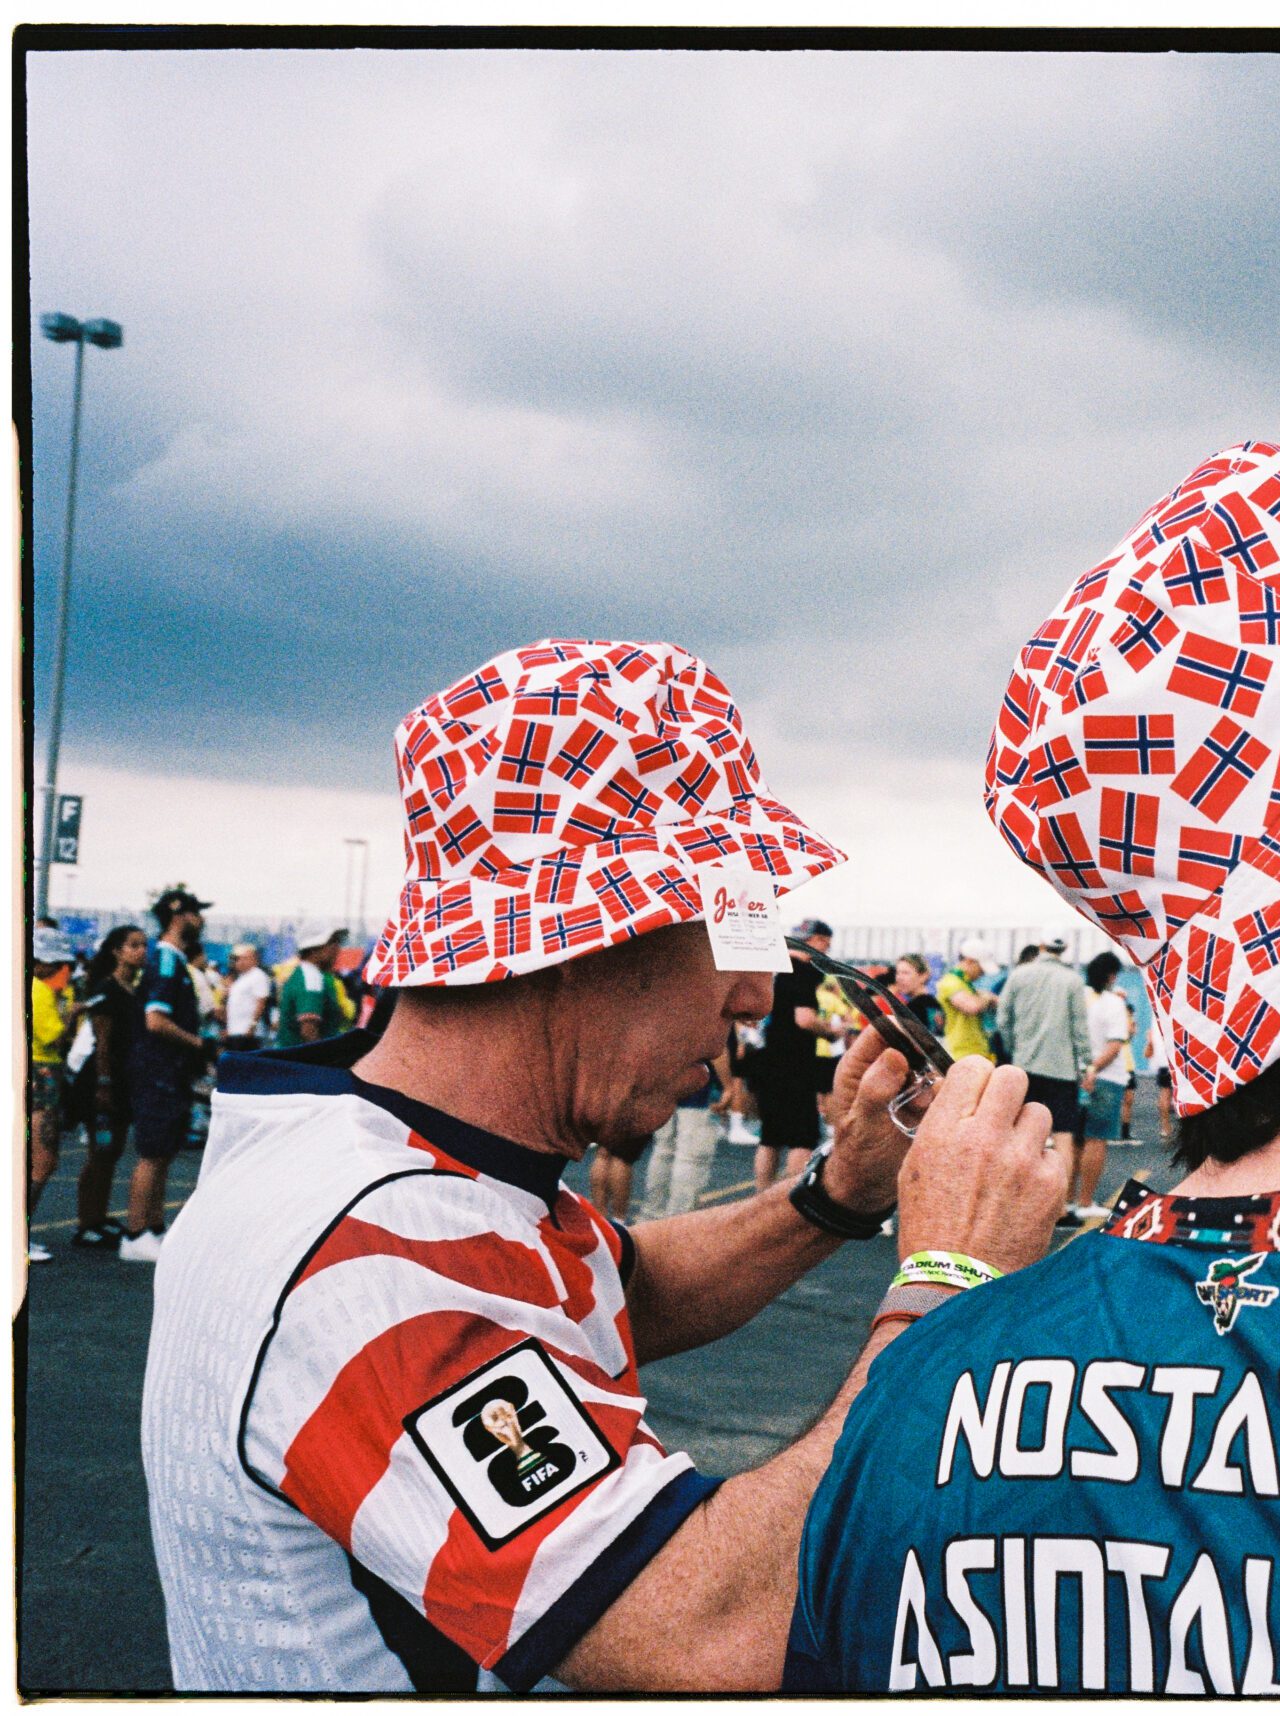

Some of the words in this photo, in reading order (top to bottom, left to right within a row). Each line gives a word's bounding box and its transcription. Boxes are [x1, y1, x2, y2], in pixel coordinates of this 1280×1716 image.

[62, 801, 79, 822] F
[713, 886, 767, 924] Joer
[902, 1261, 951, 1271] ADIUM
[954, 1264, 997, 1282] SHUT
[521, 1463, 560, 1492] FIFA
